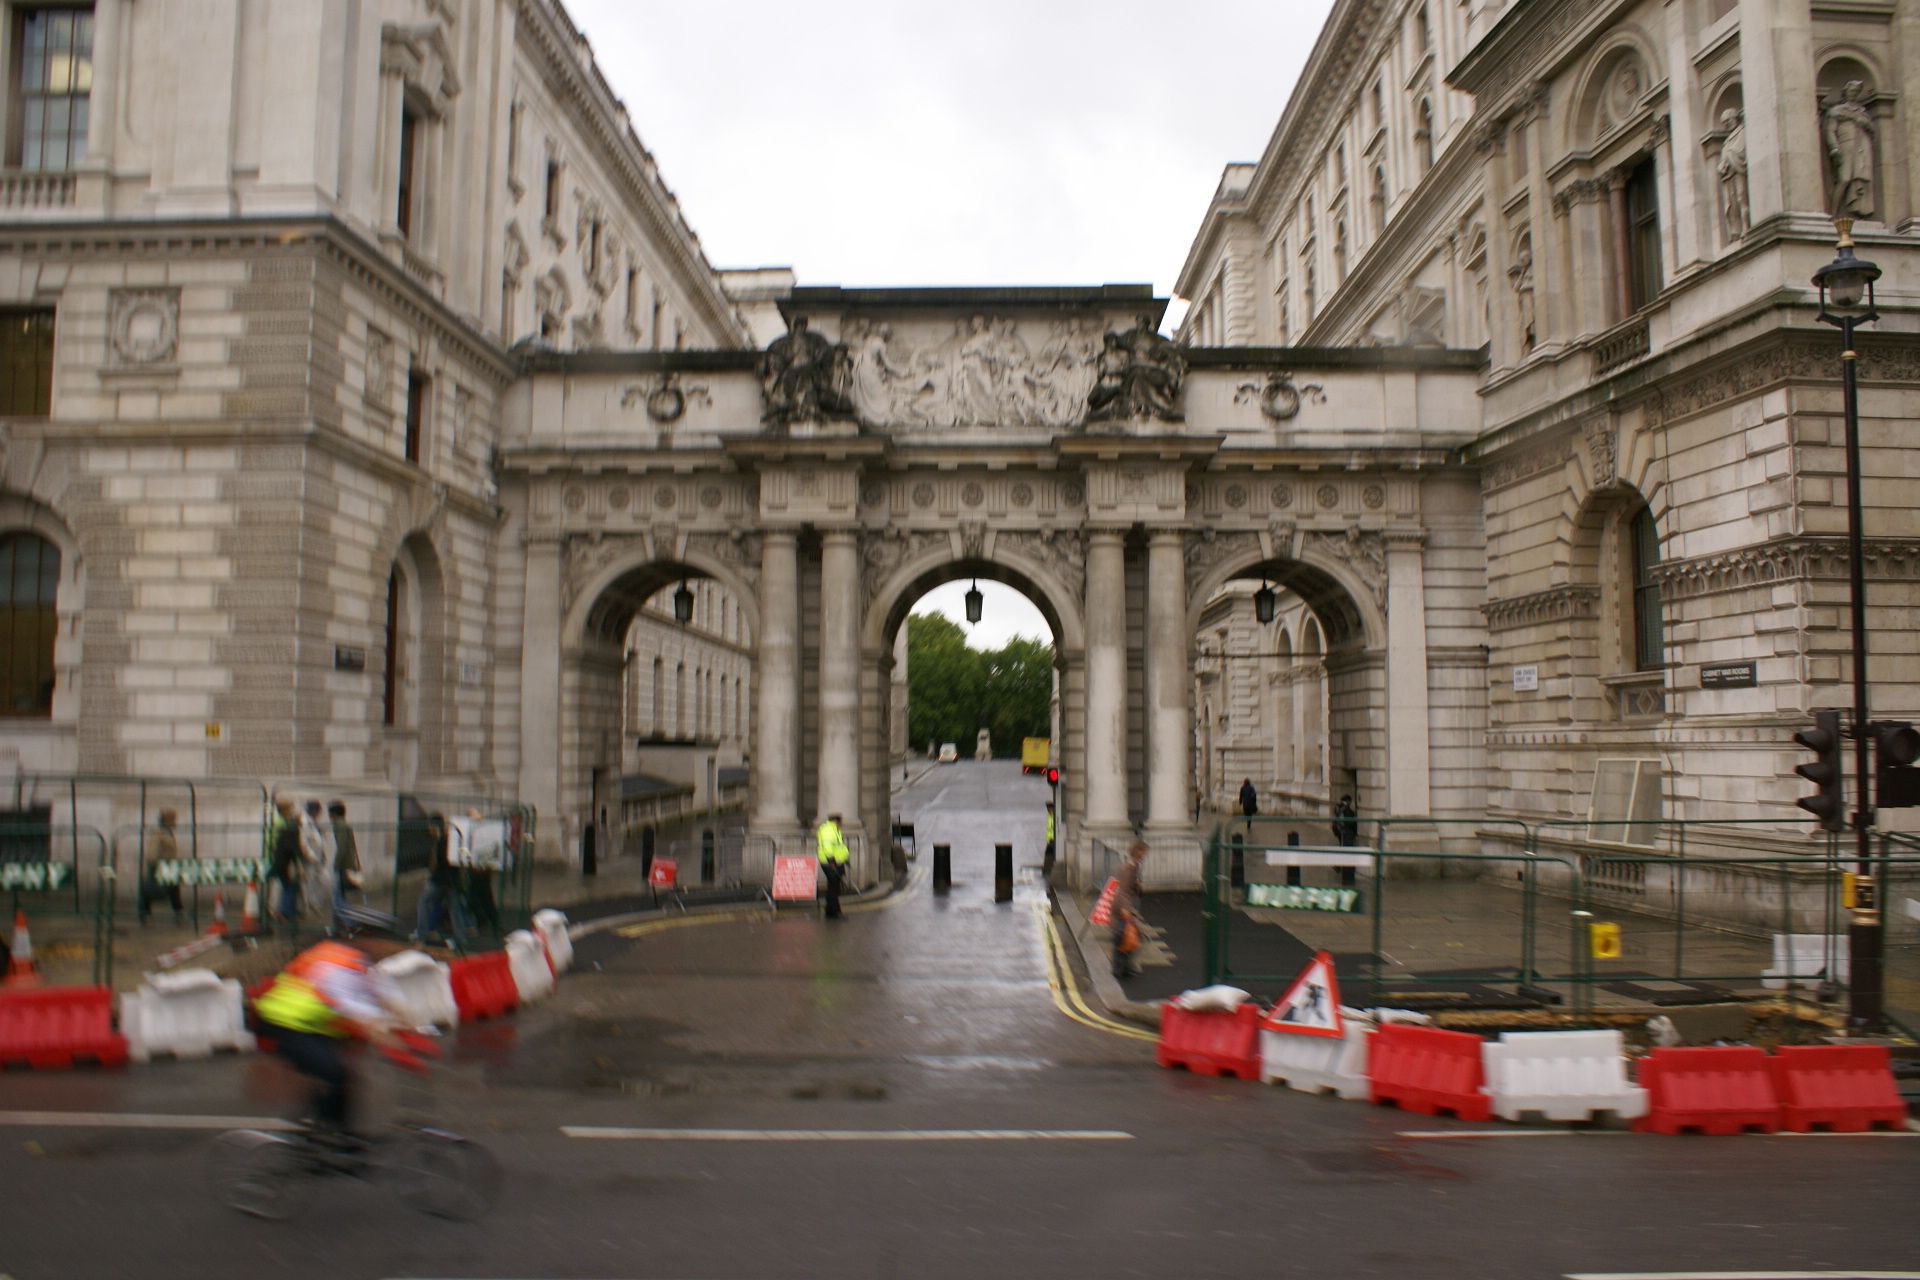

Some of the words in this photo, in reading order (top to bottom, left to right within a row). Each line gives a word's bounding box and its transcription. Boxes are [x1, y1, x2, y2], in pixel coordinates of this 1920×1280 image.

[1731, 667, 1750, 675] ROOMS
[156, 859, 271, 886] MURPHY
[1247, 883, 1358, 912] MURPHY
